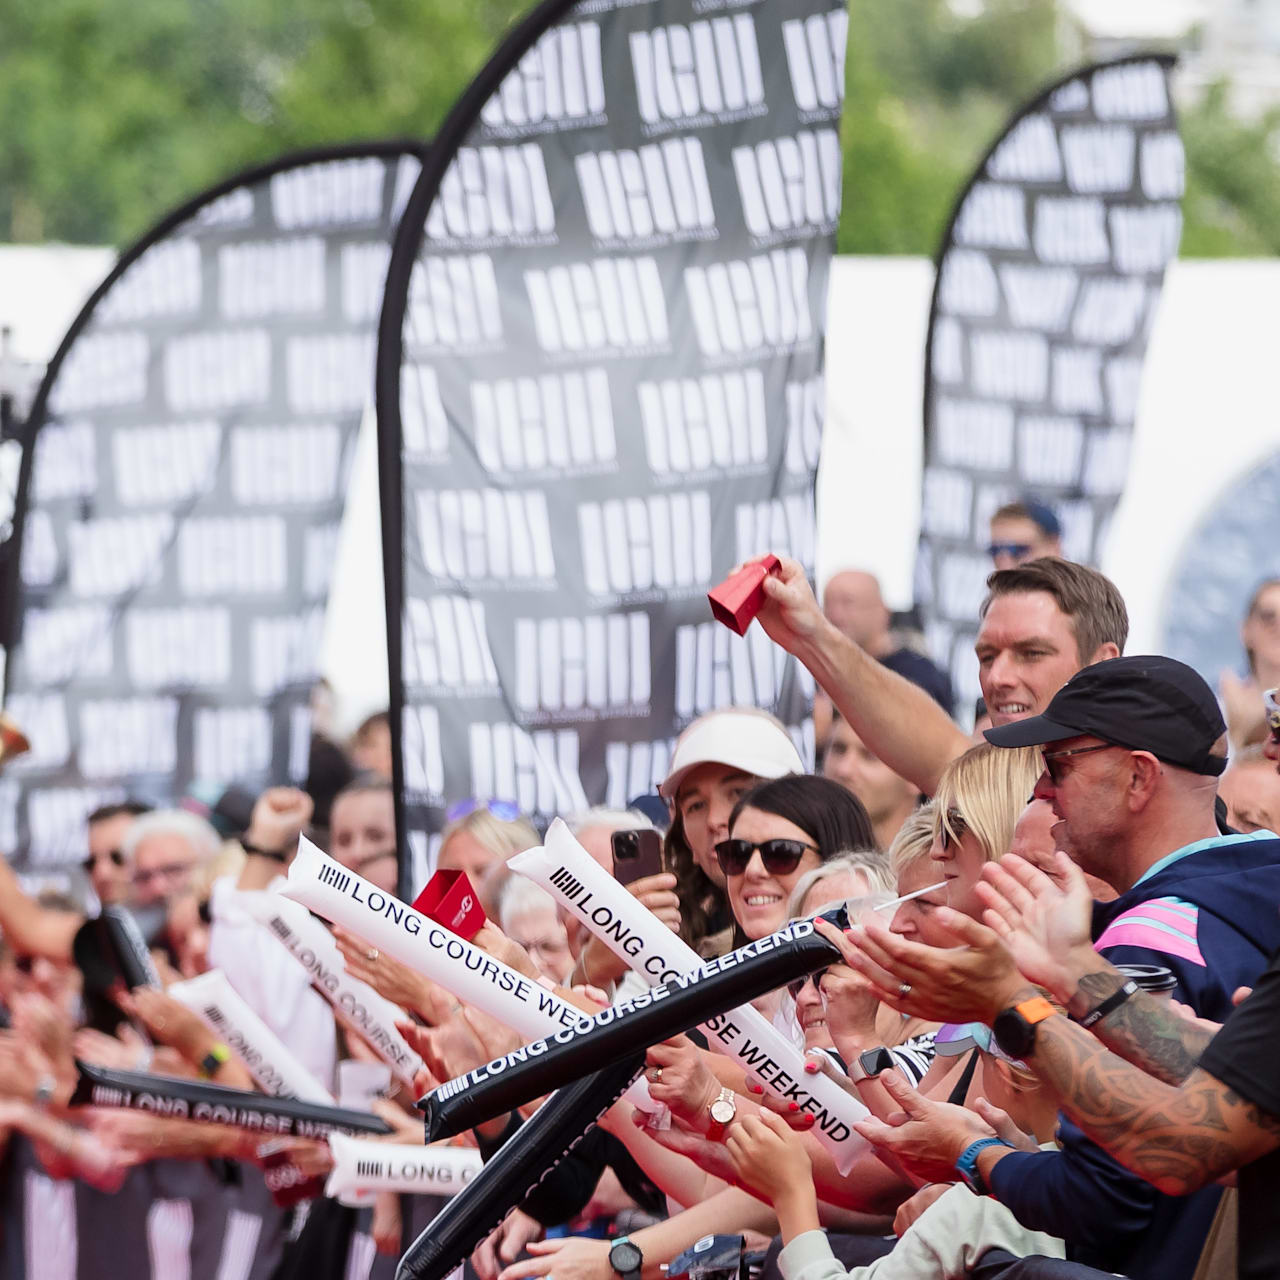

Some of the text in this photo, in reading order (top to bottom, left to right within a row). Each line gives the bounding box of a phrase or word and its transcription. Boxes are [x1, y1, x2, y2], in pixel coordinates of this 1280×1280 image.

[351, 882, 532, 1002] LONG COURSE
[577, 893, 645, 958] LONG
[287, 933, 341, 993] LONG
[472, 1038, 550, 1085] LONG
[554, 984, 671, 1044] COURSE
[676, 921, 815, 989] WEEKEND
[386, 1162, 453, 1185] LONG
